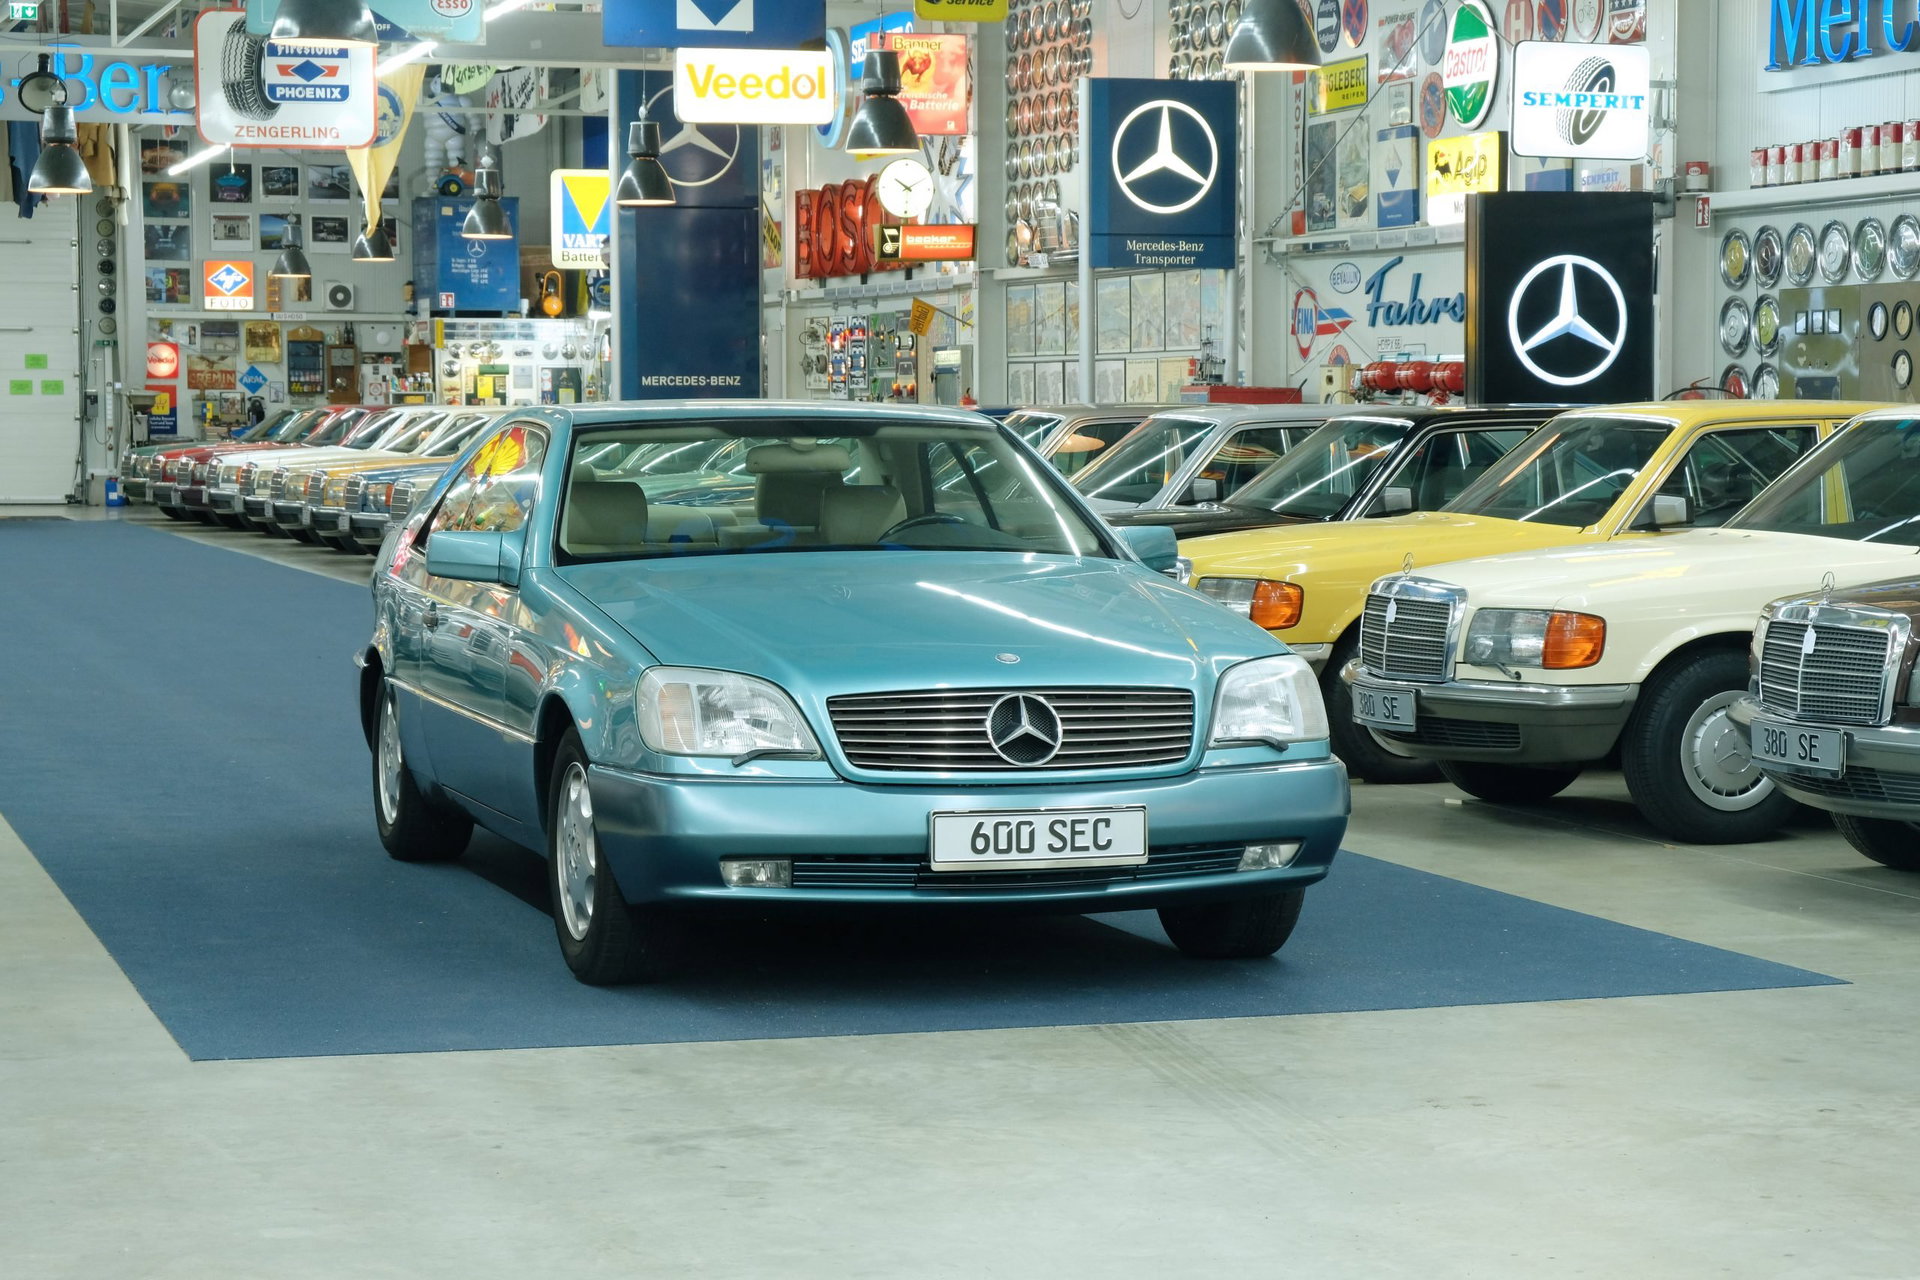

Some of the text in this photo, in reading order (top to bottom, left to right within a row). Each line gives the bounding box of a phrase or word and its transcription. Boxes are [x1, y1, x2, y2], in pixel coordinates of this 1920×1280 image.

[893, 36, 943, 50] Banner
[1764, 0, 1920, 72] Merc
[1446, 43, 1489, 80] Castrol
[686, 63, 827, 100] Veedol
[276, 87, 342, 99] PHOENIX
[1342, 91, 1365, 101] REIFEN
[1523, 91, 1645, 109] SEMPERIT
[910, 99, 960, 110] Batterie
[234, 125, 340, 139] ZENGERLING
[1454, 151, 1488, 187] Agip
[1454, 201, 1465, 214] Mo
[797, 174, 884, 277] BOSC
[562, 233, 608, 249] VART
[1126, 239, 1204, 252] Mercedes-Benz
[561, 250, 600, 262] Batter
[1134, 253, 1196, 267] Transporter
[209, 298, 249, 308] FOTO
[1297, 308, 1314, 335] FINA
[243, 375, 264, 384] ARAL
[641, 375, 741, 386] MERCEDES-BENZ
[1358, 692, 1400, 720] 380 SE
[1763, 727, 1820, 762] 380 SE
[970, 817, 1113, 855] 600 SEC
